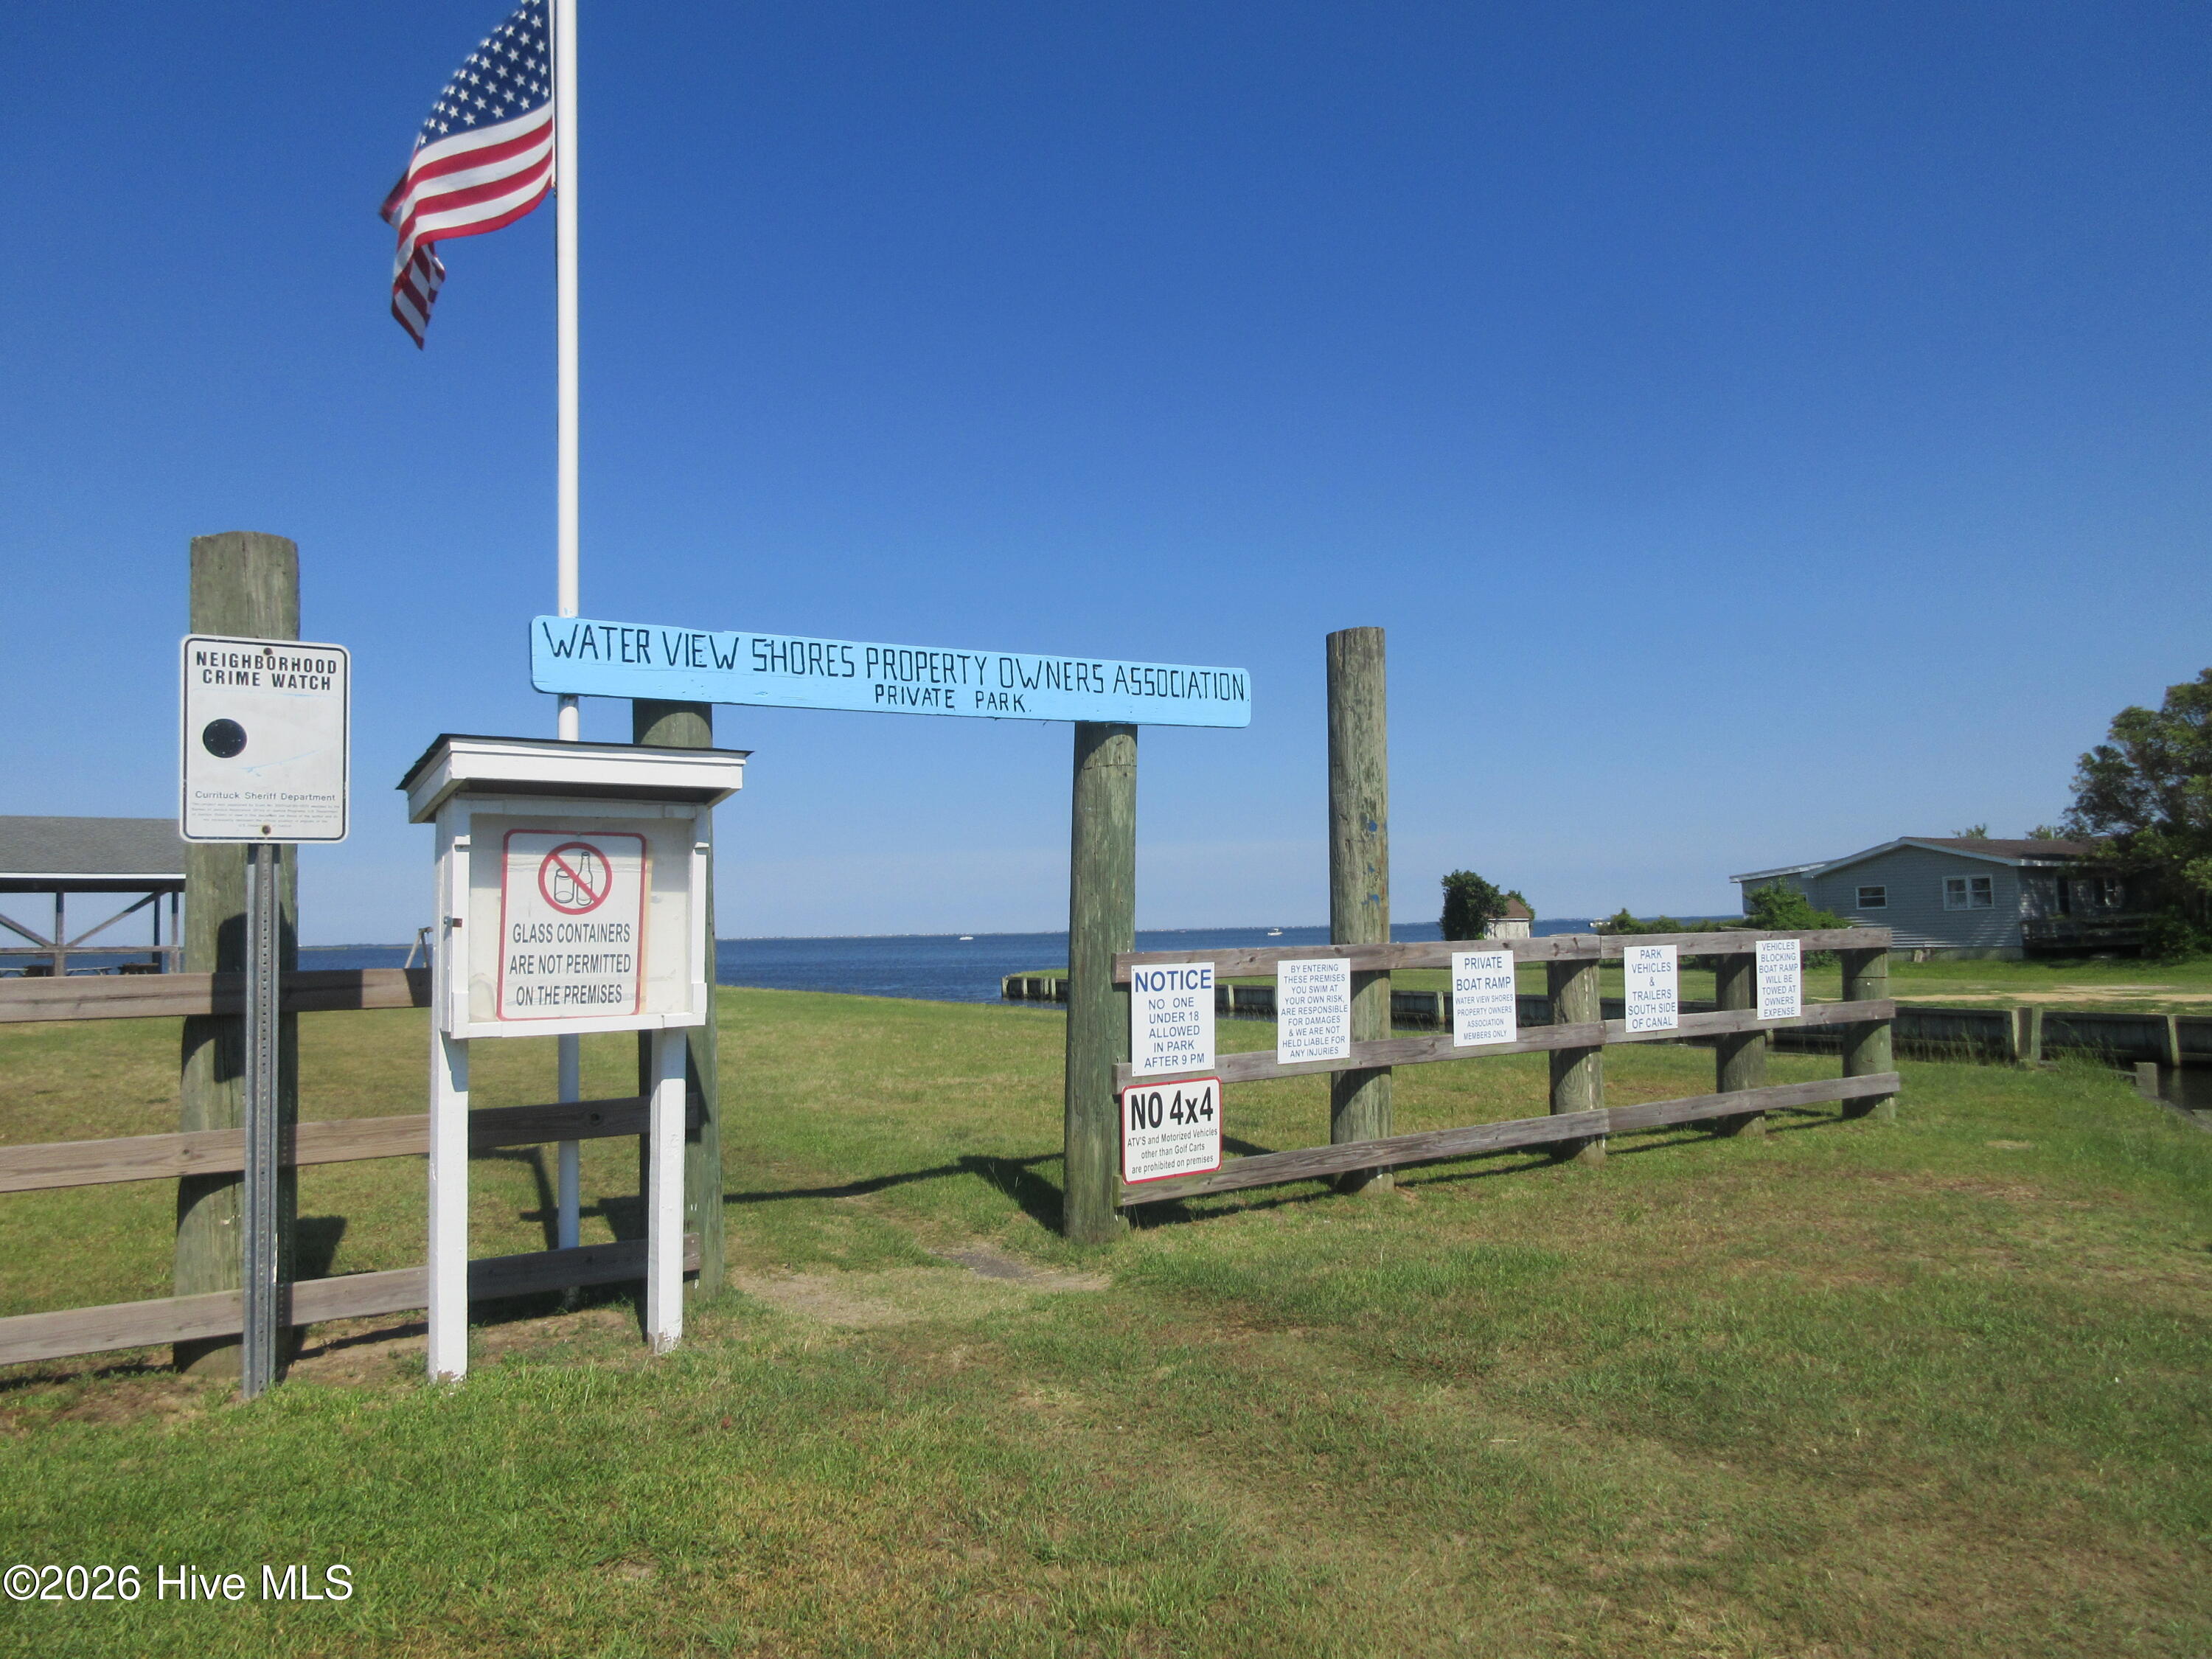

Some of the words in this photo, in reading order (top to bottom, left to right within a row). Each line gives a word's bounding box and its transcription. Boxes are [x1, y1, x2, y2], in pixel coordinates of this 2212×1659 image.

[197, 651, 337, 674] NEIGHBORHOOD
[543, 622, 651, 664] WATER
[662, 631, 739, 670] VIEW
[752, 639, 855, 678] SHORES
[866, 647, 988, 686] PROPERTY
[999, 657, 1104, 694] OWNERS
[203, 669, 261, 686] CRIME
[272, 673, 331, 690] WATCH
[875, 684, 956, 709] PRIVATE
[195, 791, 240, 799] Currituck
[245, 792, 276, 800] Sheriff
[281, 793, 335, 801] Department
[513, 923, 553, 943] GLASS
[557, 923, 630, 943] CONTAINERS
[1762, 942, 1795, 950] VEHICLES
[1641, 949, 1662, 959] PARK
[1761, 953, 1796, 961] BLOCKING
[509, 955, 534, 974] ARE
[538, 955, 563, 973] NOT
[567, 954, 631, 973] PERMITTED
[1291, 965, 1300, 973] BY
[1303, 964, 1338, 973] ENTERING
[1464, 956, 1502, 970] PRIVATE
[1632, 962, 1671, 973] VEHICLES
[1759, 964, 1777, 973] BOAT
[1779, 964, 1798, 972] RAMP
[1135, 970, 1211, 992] NOTICE
[1284, 975, 1307, 984] THESE
[1310, 974, 1345, 982] PREMISES
[1456, 978, 1482, 991] BOAT
[1485, 977, 1511, 989] RAMP
[1649, 976, 1655, 986] &
[1766, 975, 1781, 984] WILL
[516, 986, 533, 1006] ON
[538, 986, 560, 1005] THE
[564, 984, 622, 1004] PREMISES
[1632, 990, 1672, 1001] TRAILERS
[1762, 987, 1787, 995] TOWED
[1149, 999, 1165, 1009] NO
[1173, 997, 1194, 1008] ONE
[1492, 994, 1513, 1002] SHORES
[1764, 996, 1794, 1006] OWNERS
[1281, 1008, 1295, 1016] ARE
[1298, 1005, 1348, 1015] RESPONSIBLE
[1458, 1008, 1486, 1017] PROPERTY
[1489, 1006, 1512, 1014] OWNERS
[1628, 1005, 1655, 1015] SOUTH
[1658, 1003, 1675, 1012] SIDE
[1764, 1007, 1795, 1017] EXPENSE
[1150, 1012, 1185, 1023] UNDER
[1189, 1011, 1199, 1021] 18
[1288, 1018, 1303, 1026] FOR
[1305, 1015, 1340, 1025] DAMAGES
[1467, 1019, 1504, 1027] ASSOCIATION
[1632, 1019, 1643, 1029] OF
[1646, 1017, 1672, 1027] CANAL
[1149, 1026, 1200, 1038] ALLOWED
[1309, 1027, 1324, 1035] ARE
[1154, 1043, 1164, 1053] IN
[1167, 1040, 1194, 1051] PARK
[1283, 1039, 1301, 1047] HELD
[1304, 1037, 1329, 1046] LIABLE
[1331, 1036, 1345, 1044] FOR
[1307, 1047, 1339, 1056] INJURIES
[1144, 1055, 1178, 1068] AFTER
[1182, 1055, 1187, 1065] 9
[1191, 1053, 1204, 1064] PM
[1132, 1092, 1163, 1130] NO
[1170, 1087, 1213, 1125] 4x4
[1127, 1136, 1146, 1147] ATV'S
[1161, 1132, 1191, 1144] Motorized
[1193, 1127, 1217, 1138] Vehicles
[1141, 1150, 1158, 1159] other
[1159, 1148, 1172, 1156] than
[1175, 1144, 1187, 1154] Golf
[1189, 1143, 1205, 1152] Carts
[1132, 1165, 1141, 1174] are
[1144, 1160, 1175, 1174] prohibited
[1187, 1155, 1213, 1167] premises
